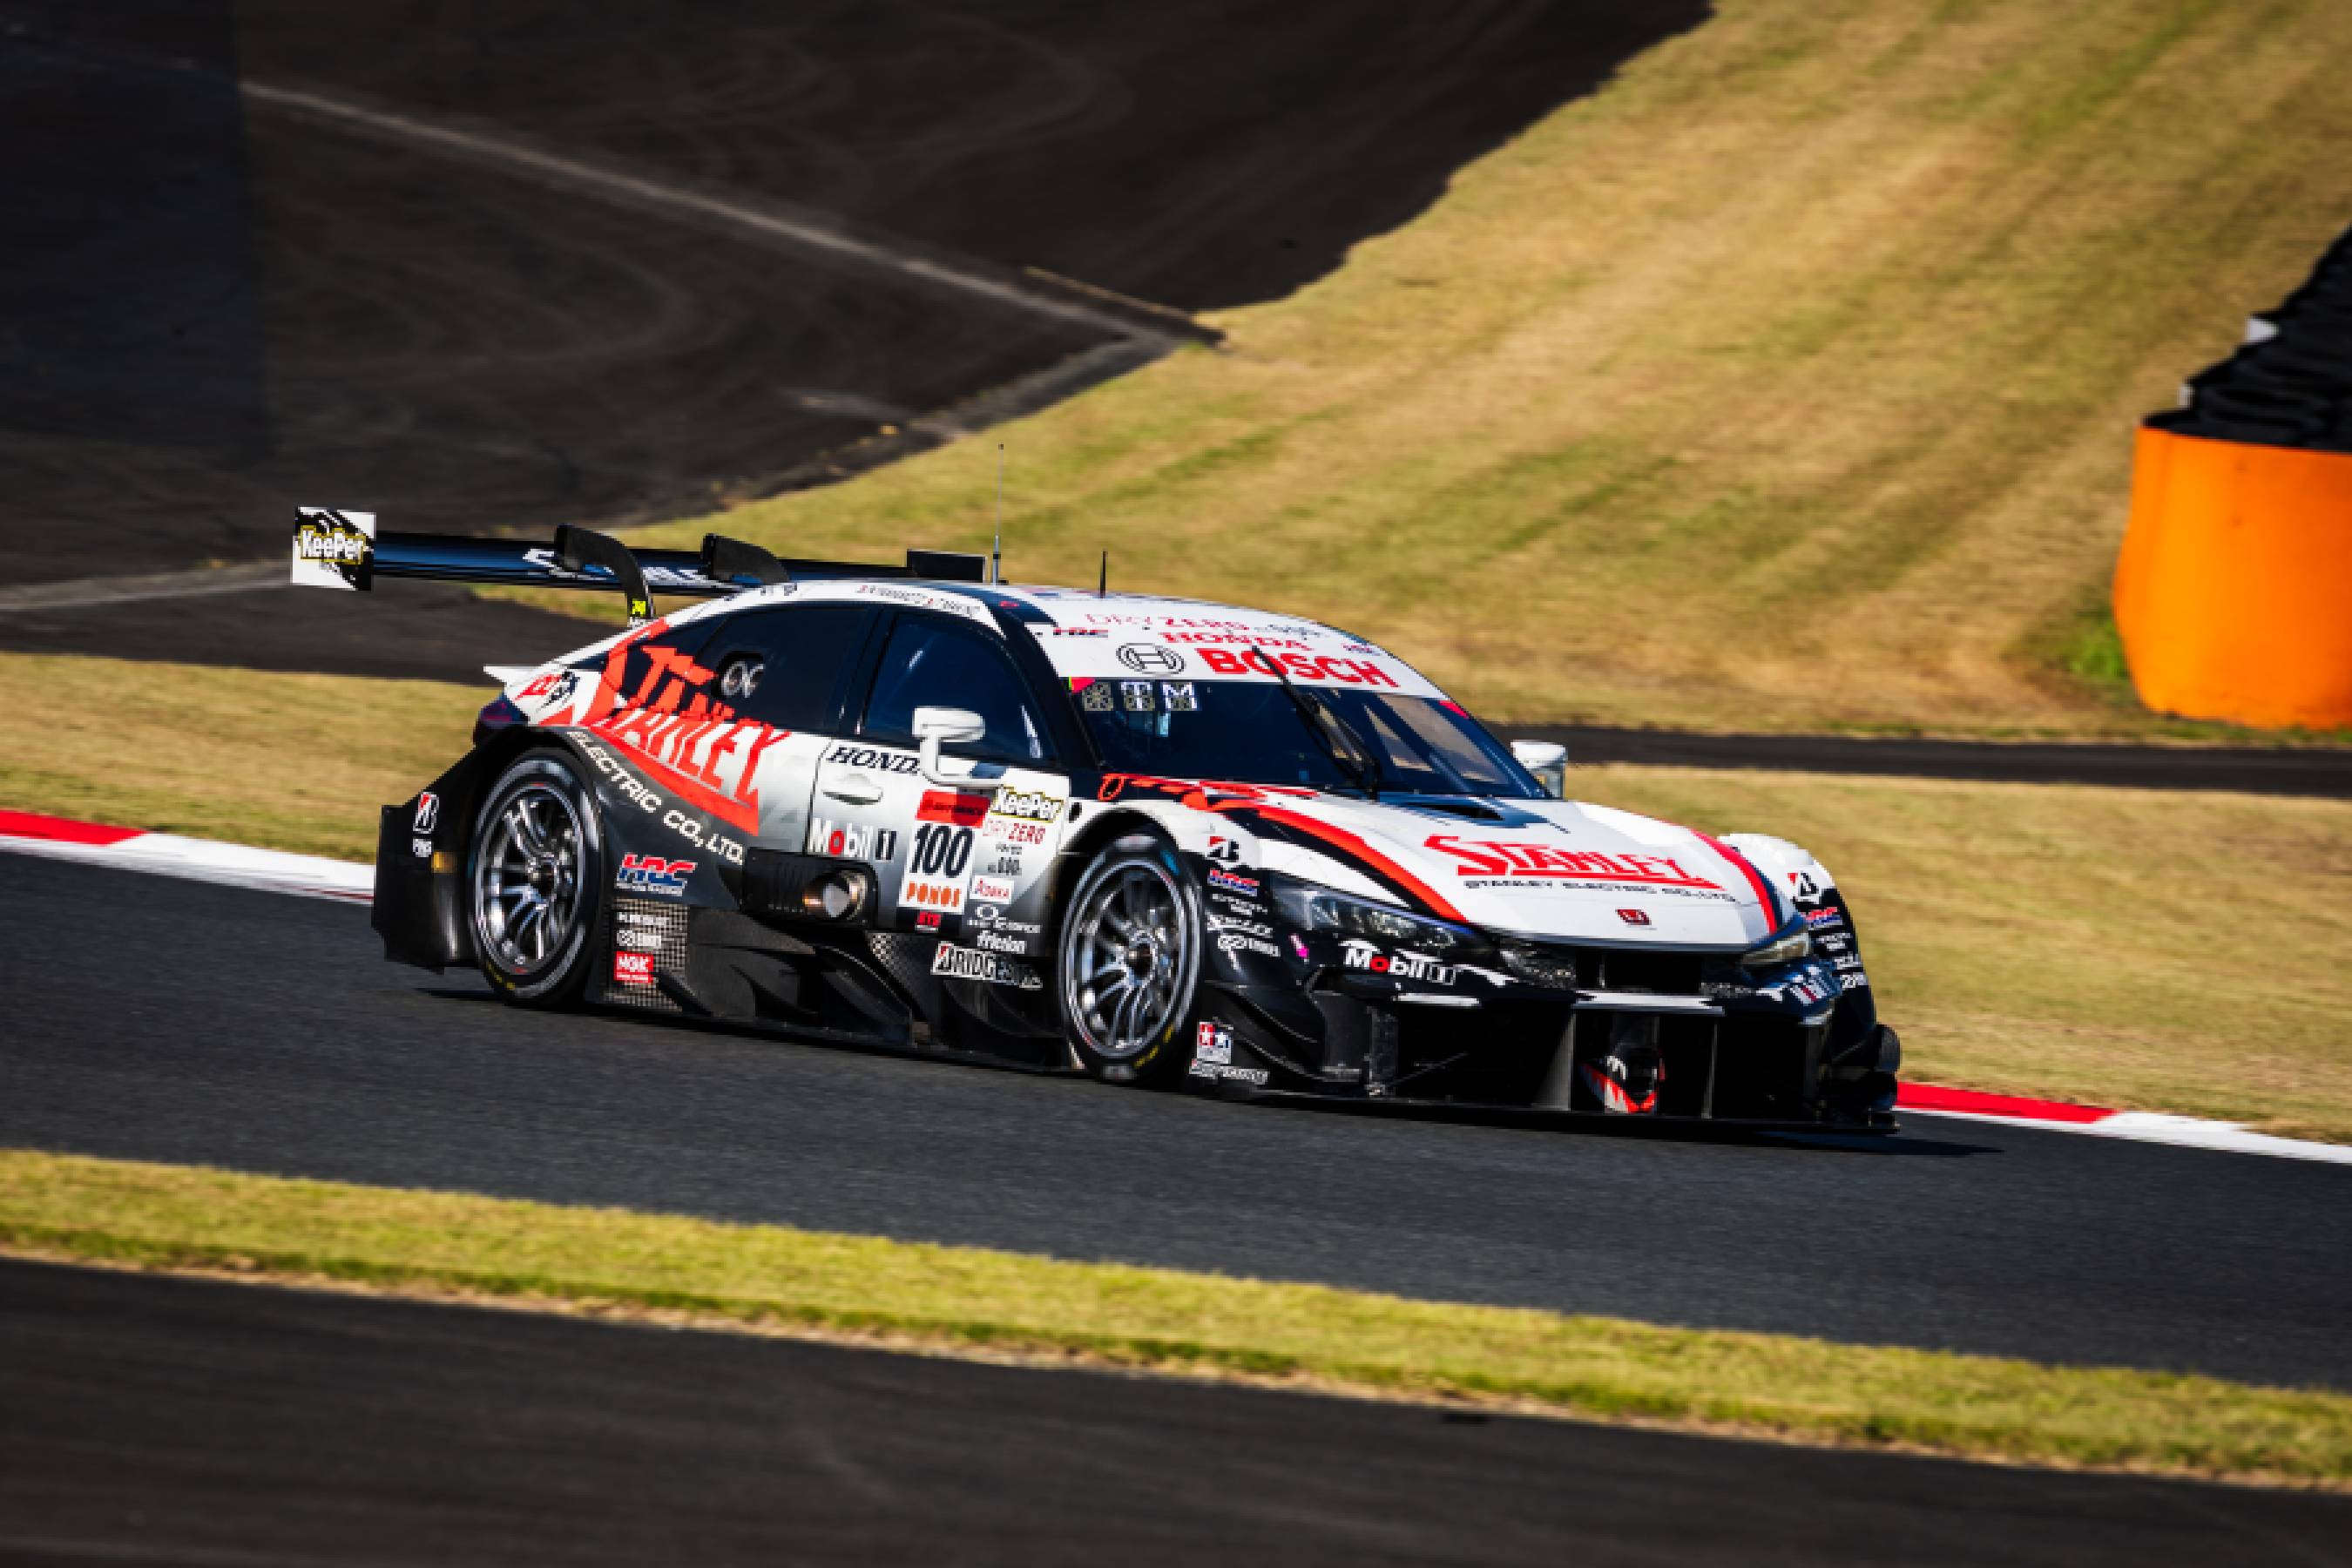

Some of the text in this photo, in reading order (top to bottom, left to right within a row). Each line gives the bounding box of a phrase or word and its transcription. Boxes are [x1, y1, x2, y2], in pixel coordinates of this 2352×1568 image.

[1196, 647, 1401, 688] BOSCH
[567, 731, 662, 813] ELECTRIC
[827, 746, 921, 774] HOND
[618, 852, 698, 889] HRC
[910, 822, 975, 878] 100
[1424, 834, 1727, 890] STANLEY
[1342, 948, 1425, 981] Mobil
